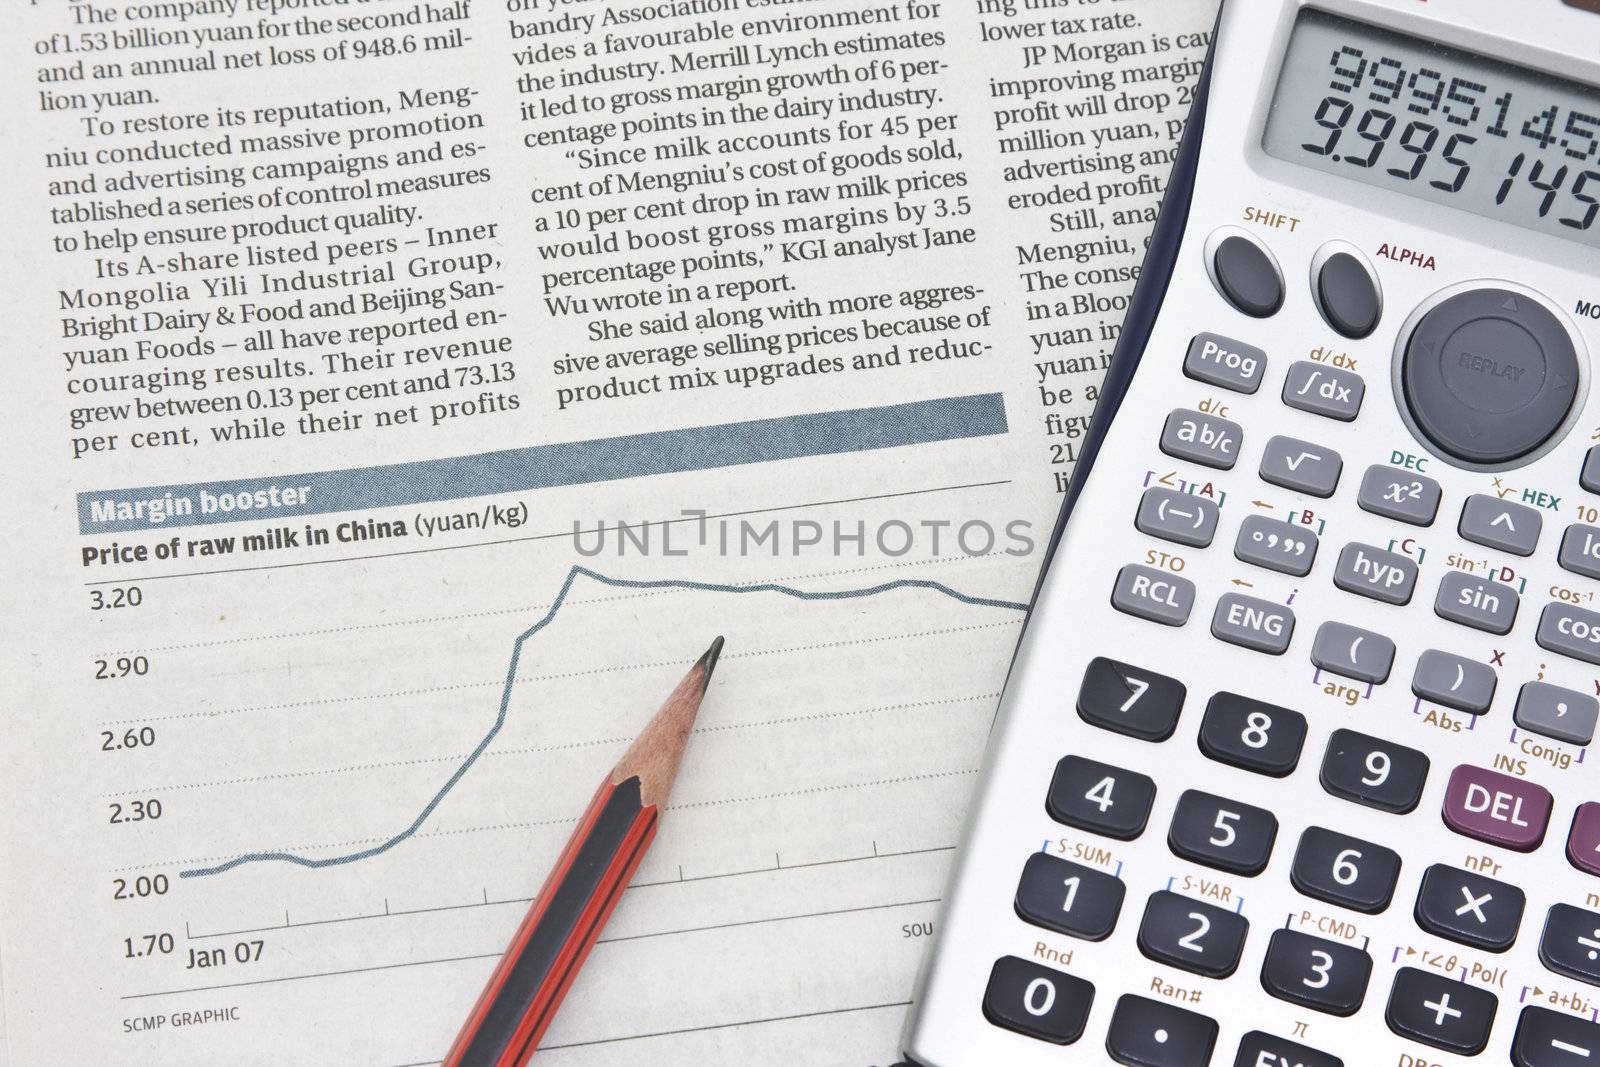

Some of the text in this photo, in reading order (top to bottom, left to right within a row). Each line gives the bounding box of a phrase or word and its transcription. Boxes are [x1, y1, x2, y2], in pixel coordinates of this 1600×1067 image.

[512, 0, 941, 66] vides a favourable environment for
[980, 13, 1141, 42] lower tax rate.
[38, 28, 472, 83] and an annual net loss of 948.6 mil-
[1023, 34, 1170, 68] JP Morgan is
[990, 70, 1116, 100] improving
[81, 87, 479, 136] To restore its reputation, Meng-
[524, 88, 943, 148] centage points in the dairy industry.
[998, 123, 1159, 153] million yuan,
[49, 141, 486, 196] and advertising campaigns and es-
[531, 181, 584, 203] cent
[589, 174, 613, 196] of
[749, 158, 798, 179] cost
[803, 151, 827, 174] of
[831, 145, 902, 176] goods
[907, 138, 962, 162] sold,
[1008, 181, 1092, 209] eroded
[53, 205, 422, 253] to help ensure product quality.
[1243, 206, 1301, 233] SHIFT
[542, 260, 676, 295] percentage
[780, 239, 828, 262] KGI
[834, 231, 919, 257] analyst
[922, 228, 976, 250] Jane
[1376, 243, 1437, 271] ALPHA
[58, 253, 501, 310] Mongolia Yili Industrial Group,
[1020, 270, 1068, 292] The
[1030, 328, 1093, 355] yuan
[67, 337, 512, 394] couraging results. Their revenue
[1201, 341, 1258, 378] Prog
[1310, 346, 1358, 371] d/dx
[1459, 352, 1526, 382] REPLAY
[556, 338, 992, 410] product mix upgrades and reduc-
[1198, 399, 1229, 418] d/c
[72, 392, 520, 459] per cent, while their net profits
[1390, 449, 1429, 473] DEC
[90, 485, 311, 523] Margin booster
[1522, 488, 1561, 511] HEX
[82, 501, 528, 567] Price of raw milk in China (yuan/kg)
[1145, 549, 1186, 572] STO
[1353, 551, 1405, 589] hyp
[90, 587, 142, 610] 3.20
[1131, 576, 1180, 608] RCL
[1457, 584, 1500, 614] sin
[1227, 603, 1284, 637] ENG
[95, 656, 149, 680] 2.90
[1119, 676, 1150, 712] 7
[1323, 679, 1361, 706] arg
[1240, 712, 1272, 749] 8
[1423, 710, 1462, 734] Abs
[101, 727, 155, 751] 2.60
[1520, 738, 1572, 769] Conjg
[1362, 750, 1391, 787] 9
[1494, 753, 1528, 776] INS
[1085, 776, 1114, 814] 4
[1463, 783, 1528, 827] DEL
[109, 799, 162, 824] 2.30
[1209, 810, 1240, 848] 5
[1057, 837, 1112, 867] S-SUM
[1333, 848, 1362, 885] 6
[1464, 854, 1503, 876] nPr
[113, 874, 169, 900] 2.00
[1062, 876, 1081, 913] 1
[1182, 874, 1233, 903] S-VAR
[1178, 913, 1210, 953] 2
[1300, 910, 1358, 940] P-CMD
[124, 933, 174, 958] 1.70
[186, 940, 264, 969] Jan 07
[1033, 941, 1074, 966] Rnd
[1303, 951, 1334, 989] 3
[1150, 976, 1203, 1004] Ran#
[123, 1007, 239, 1032] SCMP GRAPHIC
